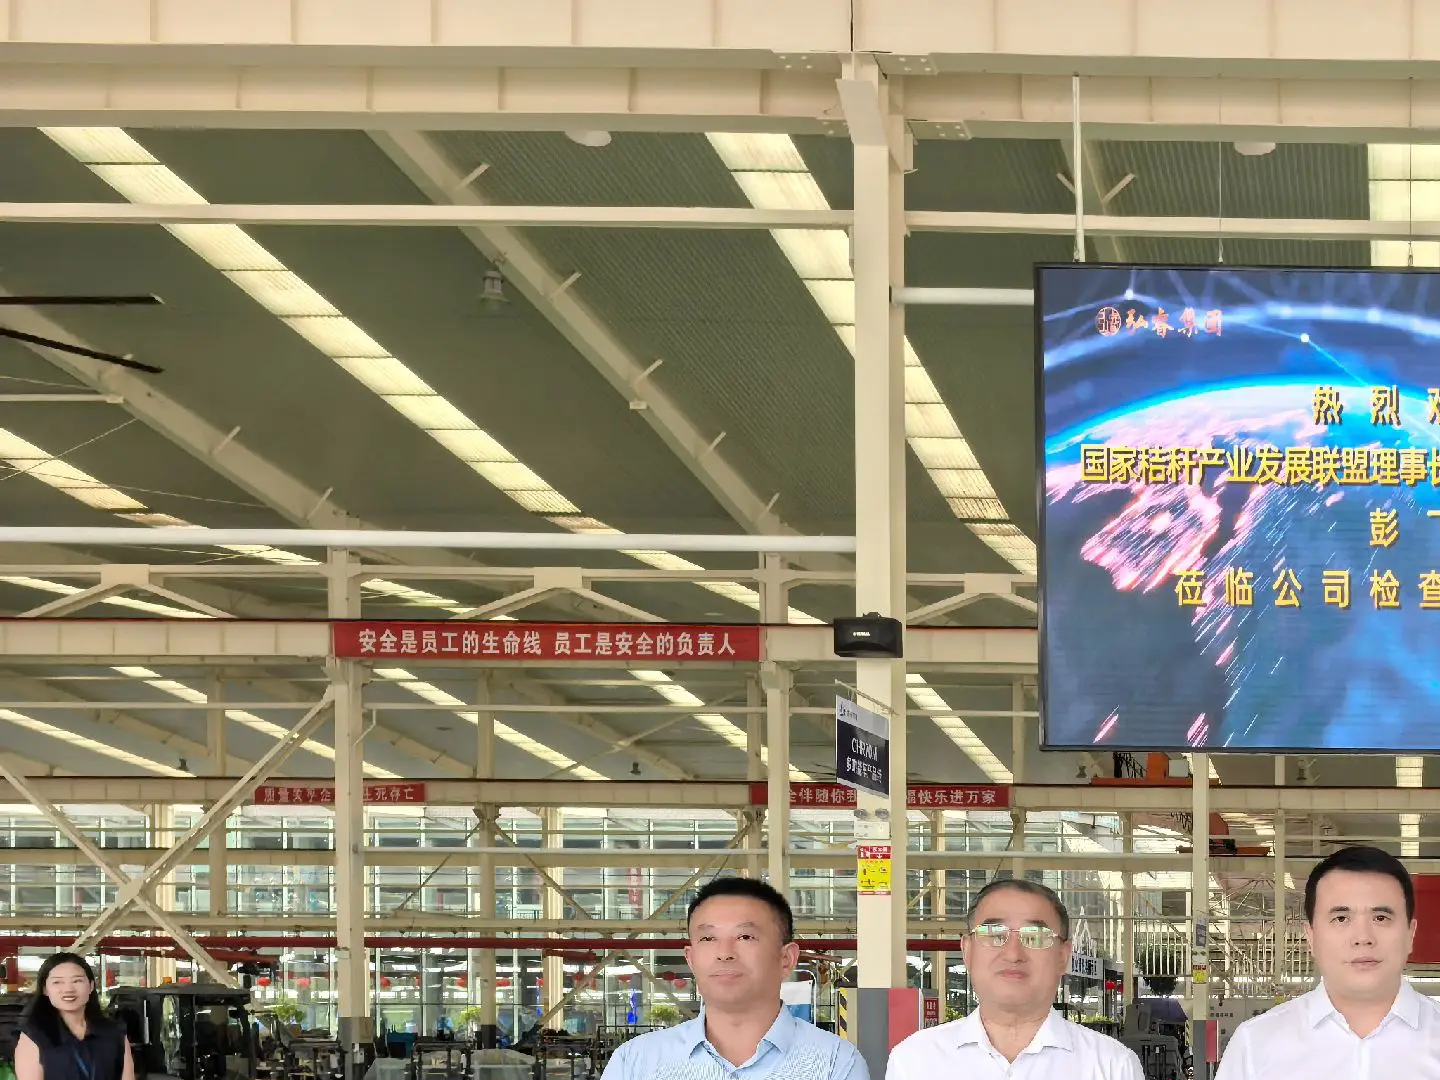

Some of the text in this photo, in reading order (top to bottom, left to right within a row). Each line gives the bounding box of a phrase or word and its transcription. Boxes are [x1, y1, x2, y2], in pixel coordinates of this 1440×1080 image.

[358, 629, 736, 656] 安全是员工的生命线 员工是安全的负责人
[906, 789, 997, 805] 福快乐进万家
